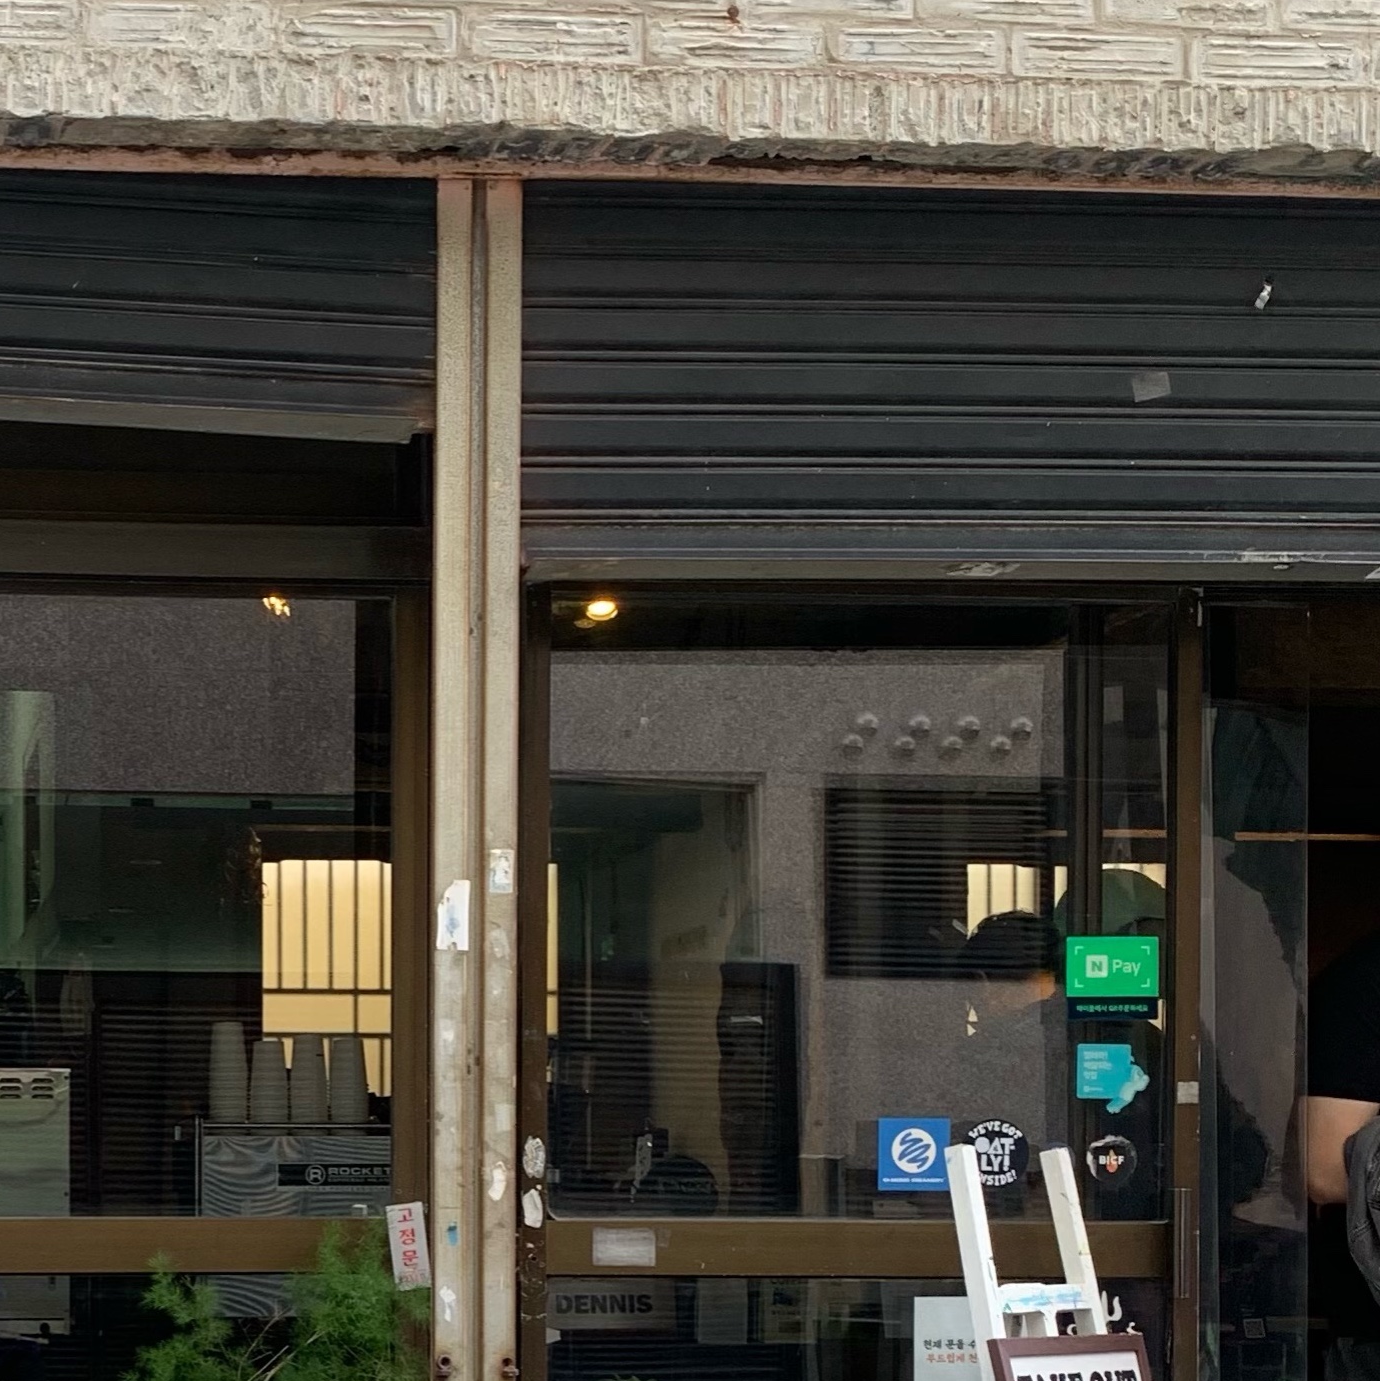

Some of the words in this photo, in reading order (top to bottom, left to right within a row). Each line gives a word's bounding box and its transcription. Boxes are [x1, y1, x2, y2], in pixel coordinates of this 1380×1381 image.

[1112, 959, 1141, 977] Pay
[968, 1121, 1002, 1139] WE'VE
[1002, 1123, 1024, 1140] GOT
[328, 1166, 391, 1175] ROCKET
[980, 1154, 1011, 1172] LY!
[978, 1169, 1018, 1186] NSIDE!
[555, 1293, 654, 1315] DENNIS
